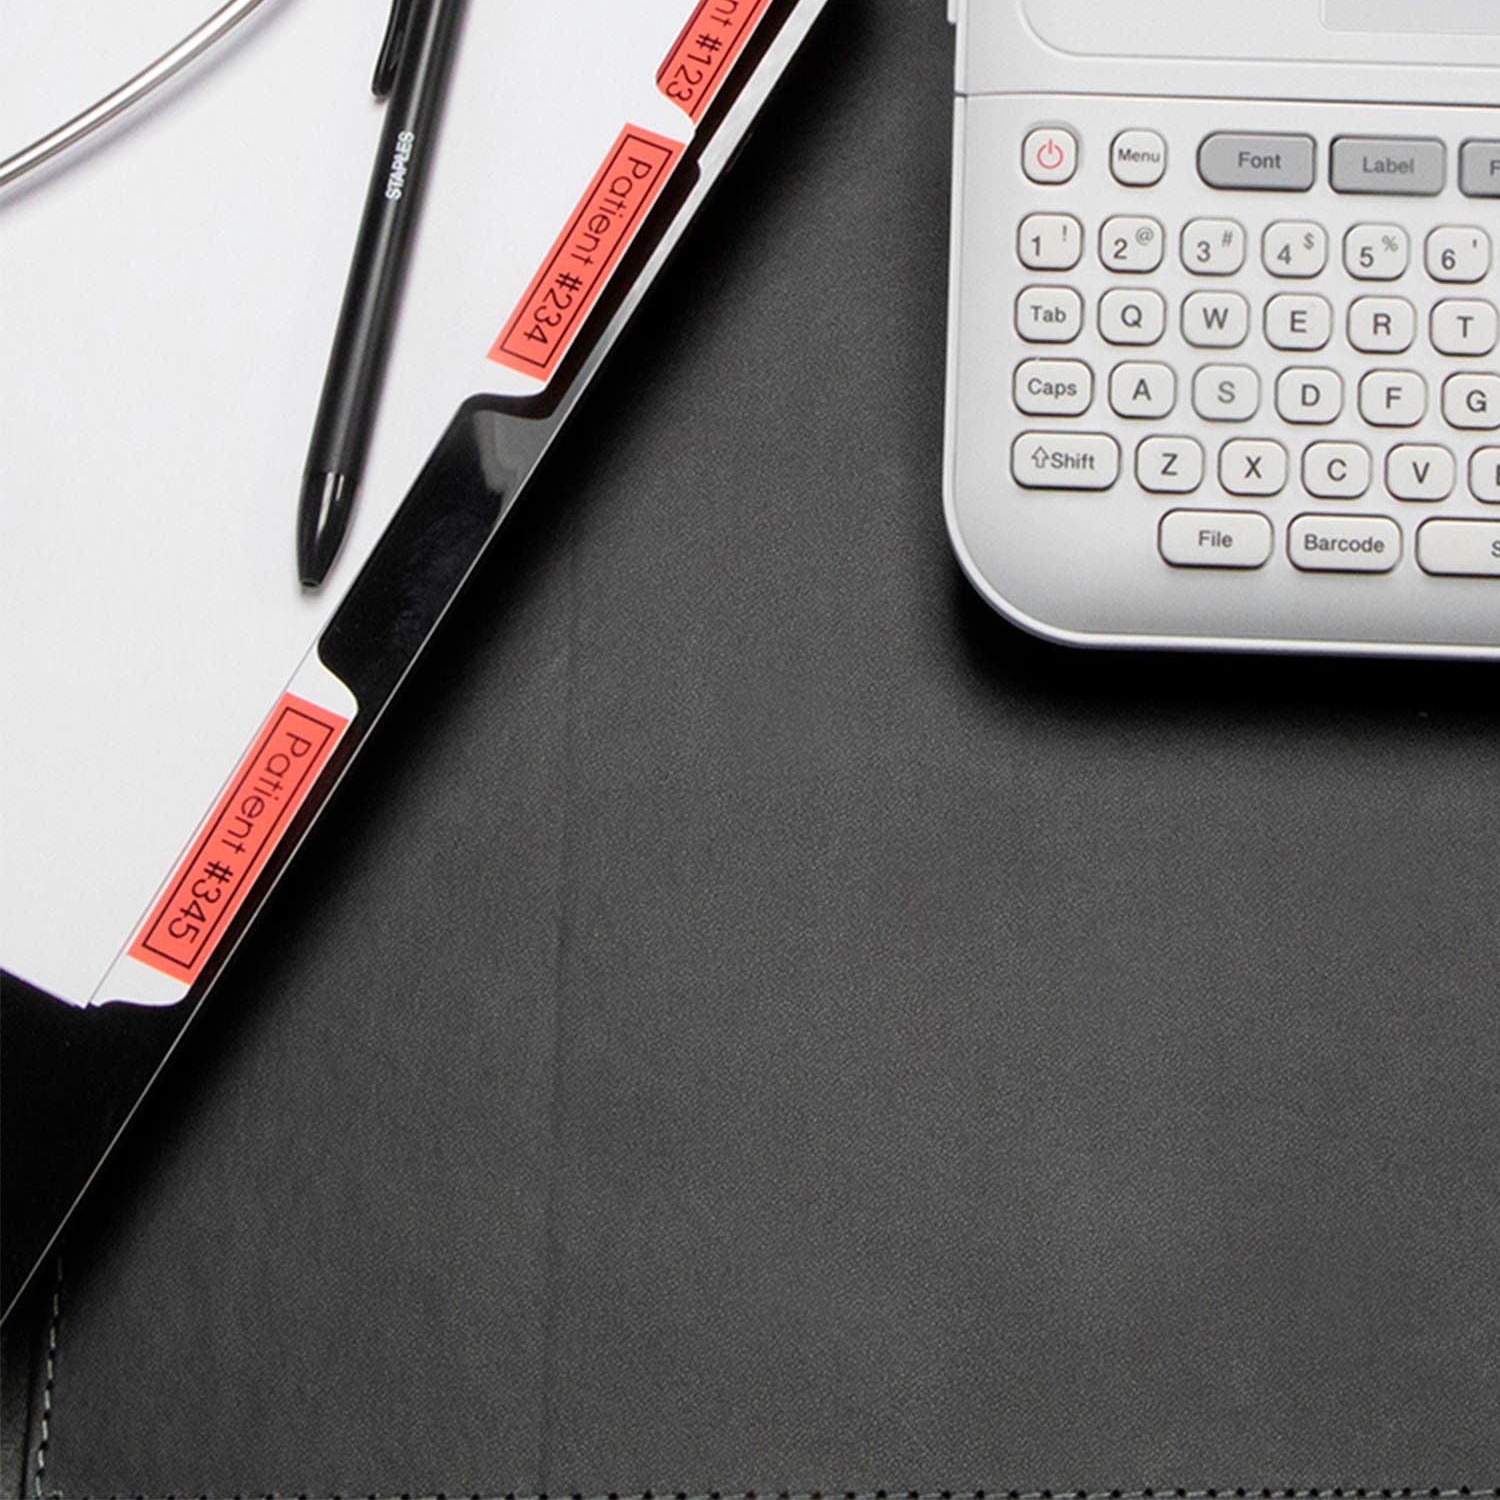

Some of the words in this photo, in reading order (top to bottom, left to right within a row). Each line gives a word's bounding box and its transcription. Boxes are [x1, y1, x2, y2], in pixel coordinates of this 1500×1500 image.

[665, 33, 723, 103] #123
[385, 130, 414, 201] STAPLES
[1118, 148, 1161, 163] Menu
[1238, 152, 1281, 169] Font
[1362, 157, 1415, 175] Label
[571, 156, 652, 266] Patient
[1031, 235, 1041, 257] 1
[1113, 238, 1128, 260] 2
[1196, 240, 1211, 262] 3
[1277, 244, 1292, 265] 4
[1359, 246, 1374, 268] 5
[1440, 248, 1456, 271] 6
[523, 272, 583, 345] #234
[1031, 305, 1066, 323] Tab
[1120, 304, 1143, 328] Q
[1202, 307, 1229, 330] W
[1290, 310, 1308, 334] E
[1373, 313, 1392, 336] R
[1456, 315, 1474, 339] T
[1027, 378, 1078, 399] Caps
[1132, 379, 1152, 401] A
[1217, 381, 1236, 404] S
[1301, 384, 1321, 406] D
[1385, 387, 1402, 409] F
[1466, 390, 1488, 413] G
[1051, 453, 1095, 471] Shift
[1161, 453, 1178, 476] Z
[1244, 456, 1262, 479] X
[1327, 459, 1348, 482] C
[1412, 462, 1430, 484] V
[1198, 530, 1233, 548] File
[1304, 534, 1385, 553] Barcode
[221, 731, 312, 854] Patient
[168, 860, 234, 943] #345
